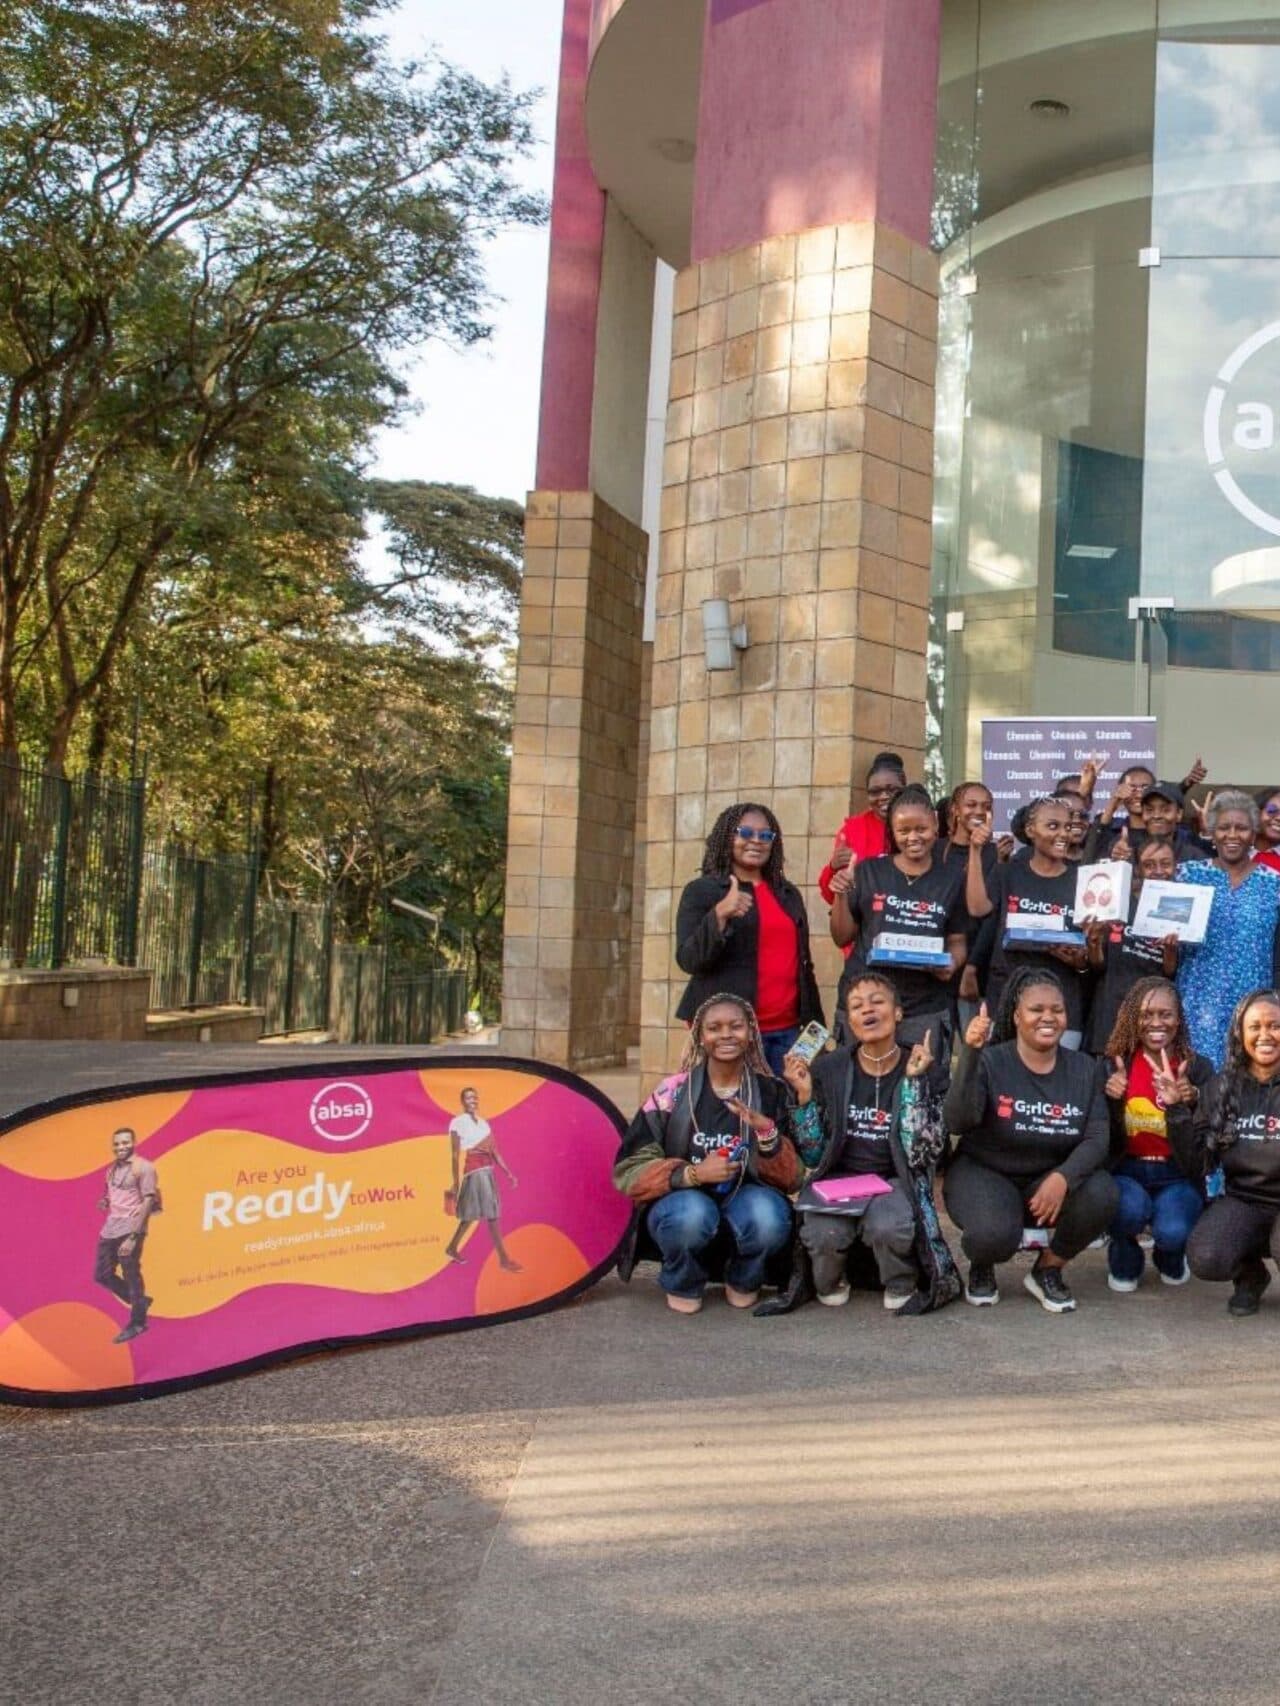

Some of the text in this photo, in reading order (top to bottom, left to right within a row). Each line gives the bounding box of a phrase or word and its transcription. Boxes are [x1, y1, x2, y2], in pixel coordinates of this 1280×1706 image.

[317, 1100, 366, 1120] absa
[236, 1164, 307, 1186] Are you
[202, 1171, 352, 1231] Ready
